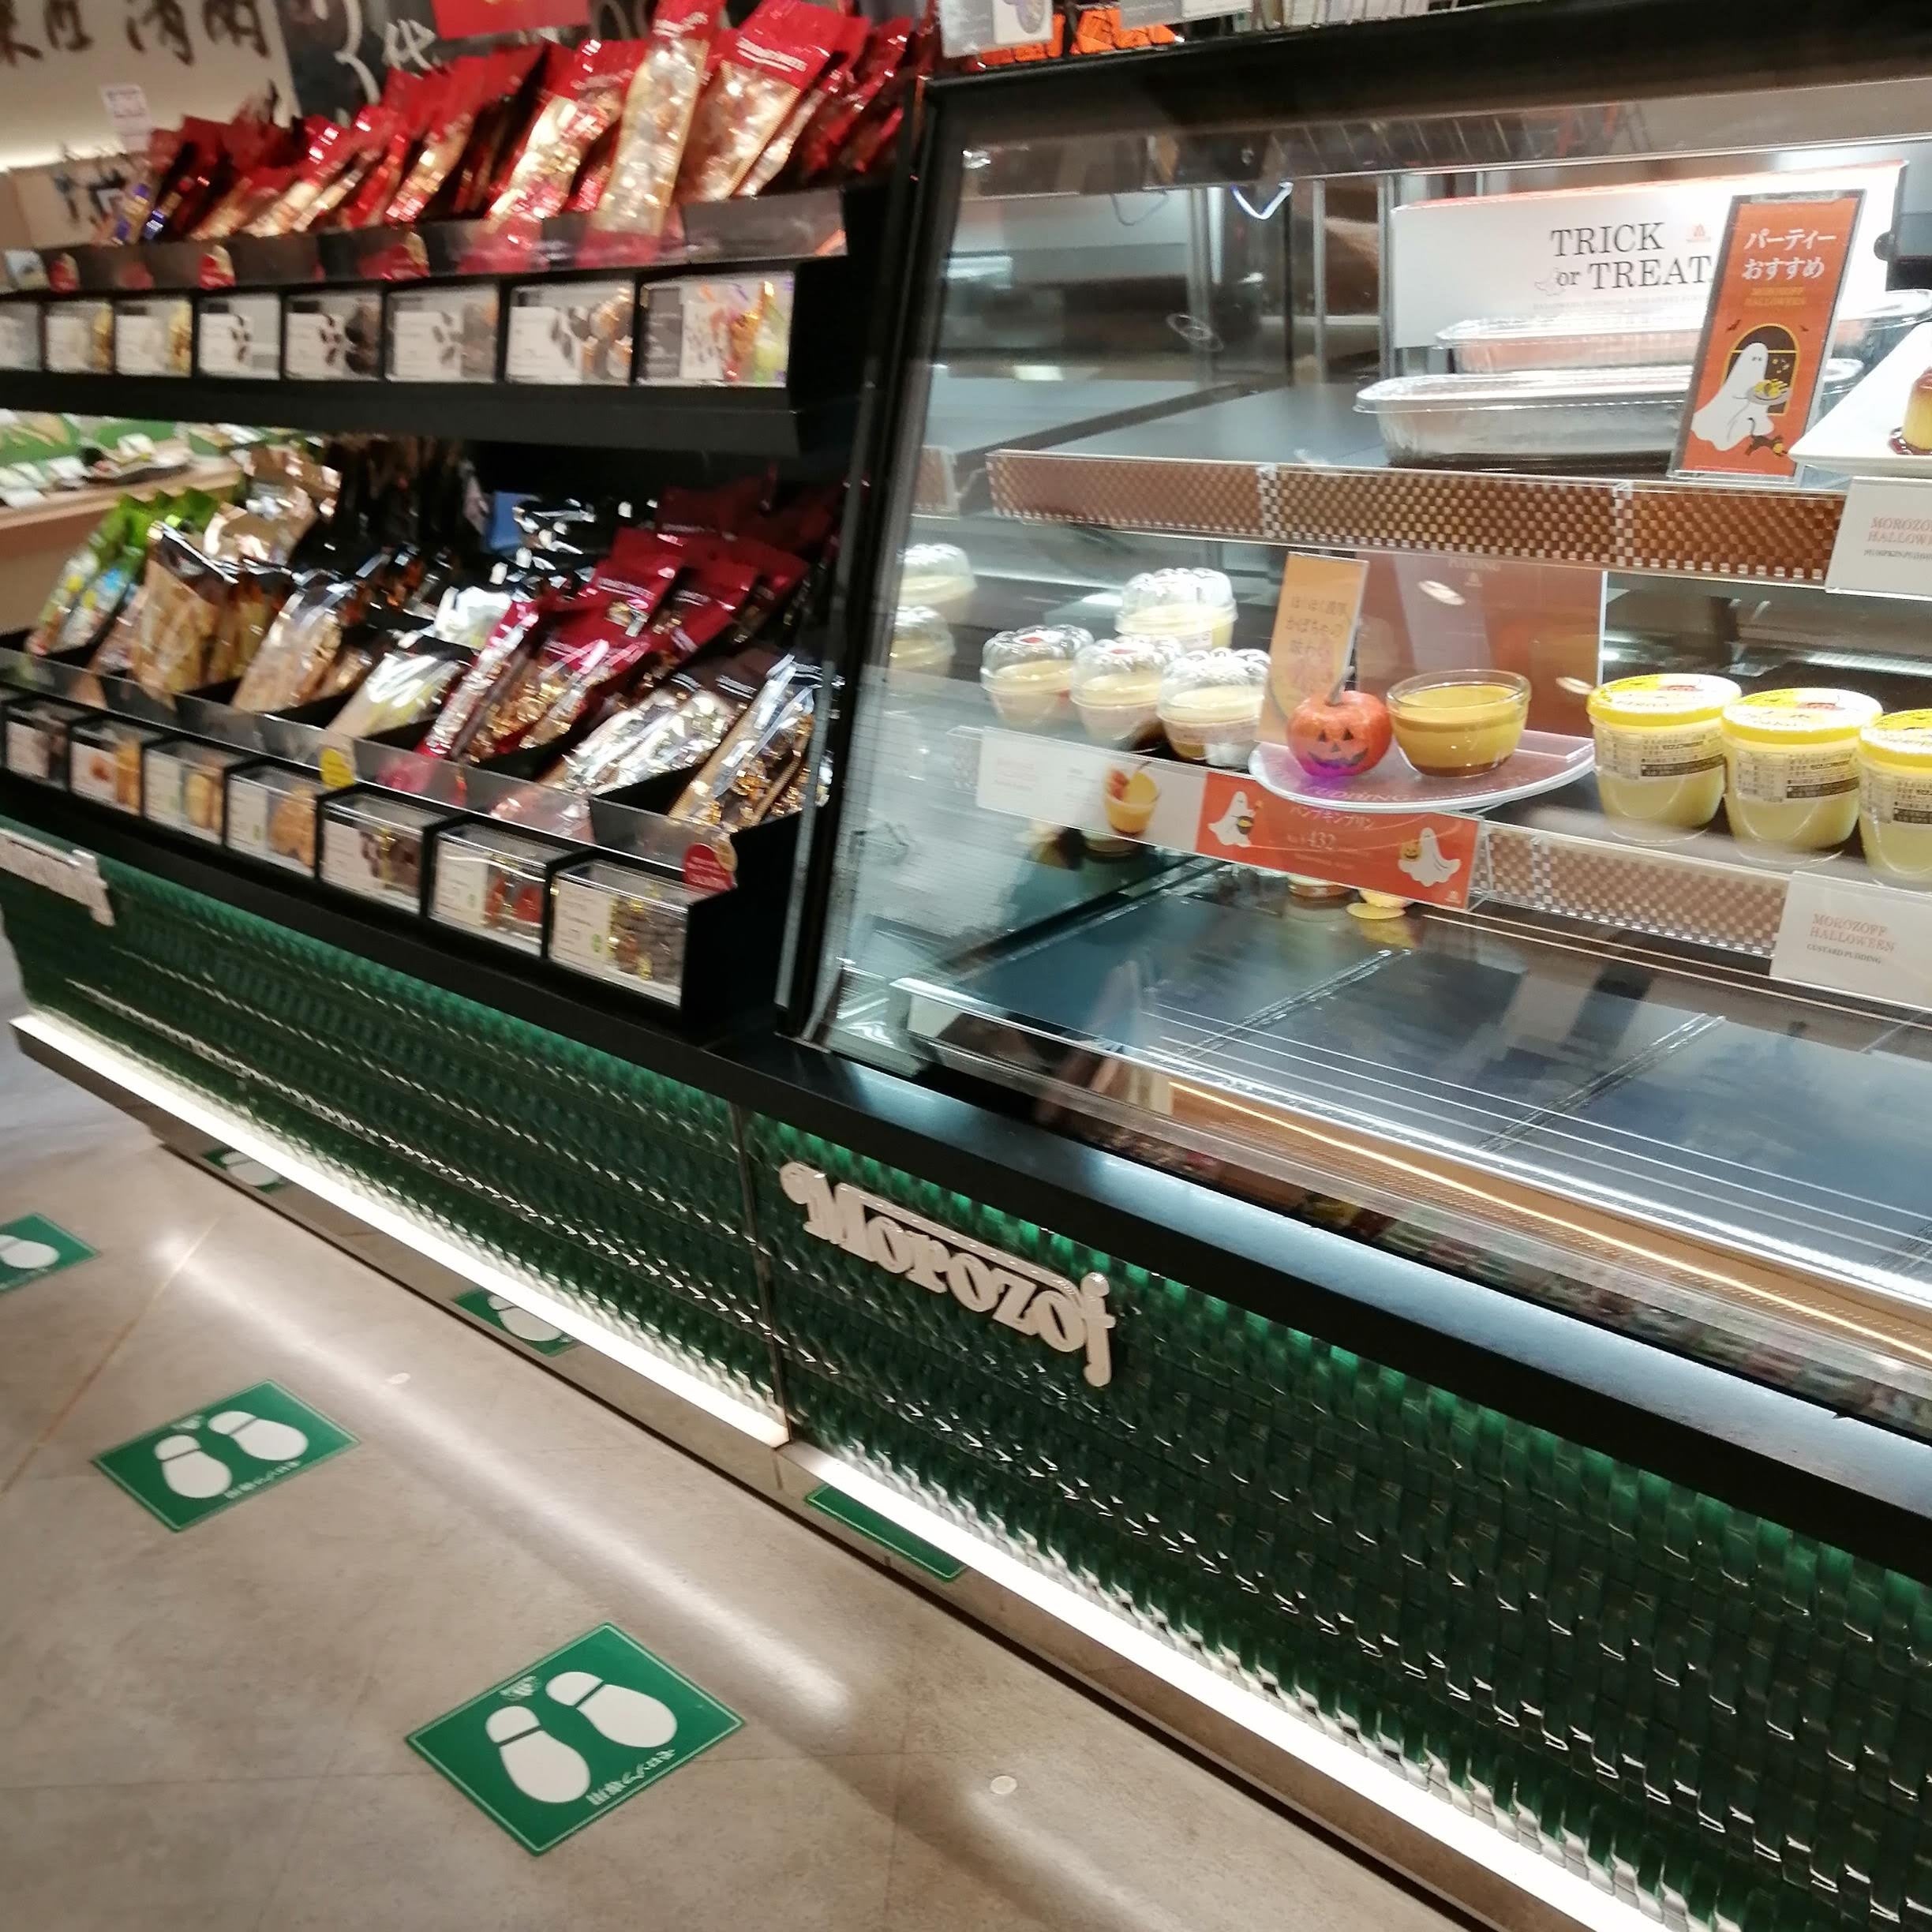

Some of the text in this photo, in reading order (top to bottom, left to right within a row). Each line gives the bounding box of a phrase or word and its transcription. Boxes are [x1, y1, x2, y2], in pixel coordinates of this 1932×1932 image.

[1549, 222, 1665, 257] TRICK
[1743, 227, 1837, 252] パーティー
[1556, 255, 1712, 290] or TREAT
[1741, 256, 1825, 281] おすすめ
